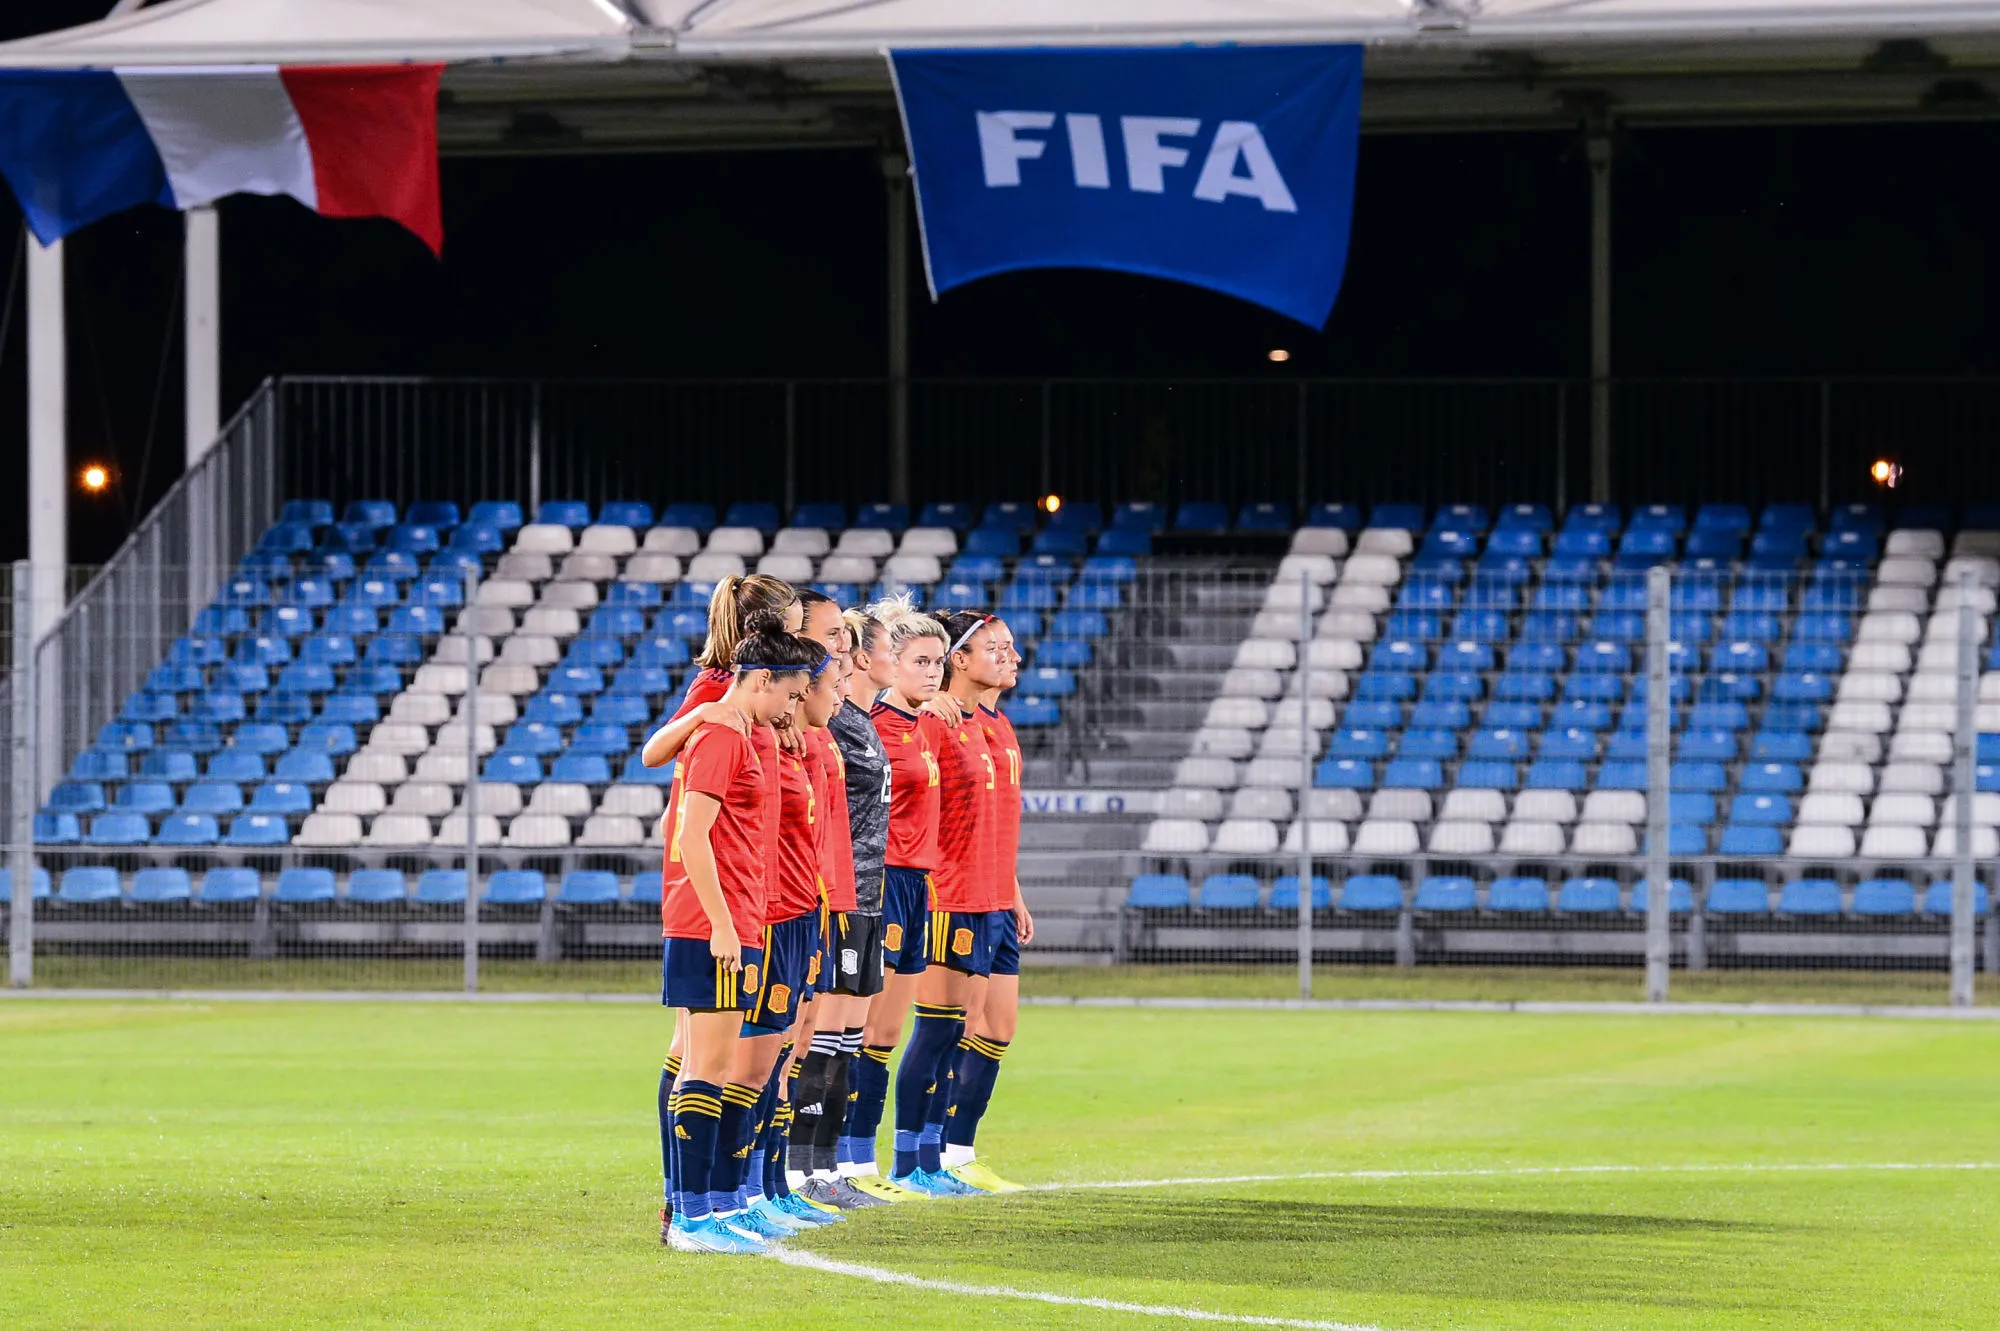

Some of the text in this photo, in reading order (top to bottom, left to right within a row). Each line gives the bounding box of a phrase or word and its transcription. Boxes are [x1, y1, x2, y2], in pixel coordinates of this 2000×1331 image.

[976, 110, 1298, 213] FIFA
[920, 751, 939, 787] 16
[980, 754, 995, 790] 3
[1005, 748, 1019, 785] 11
